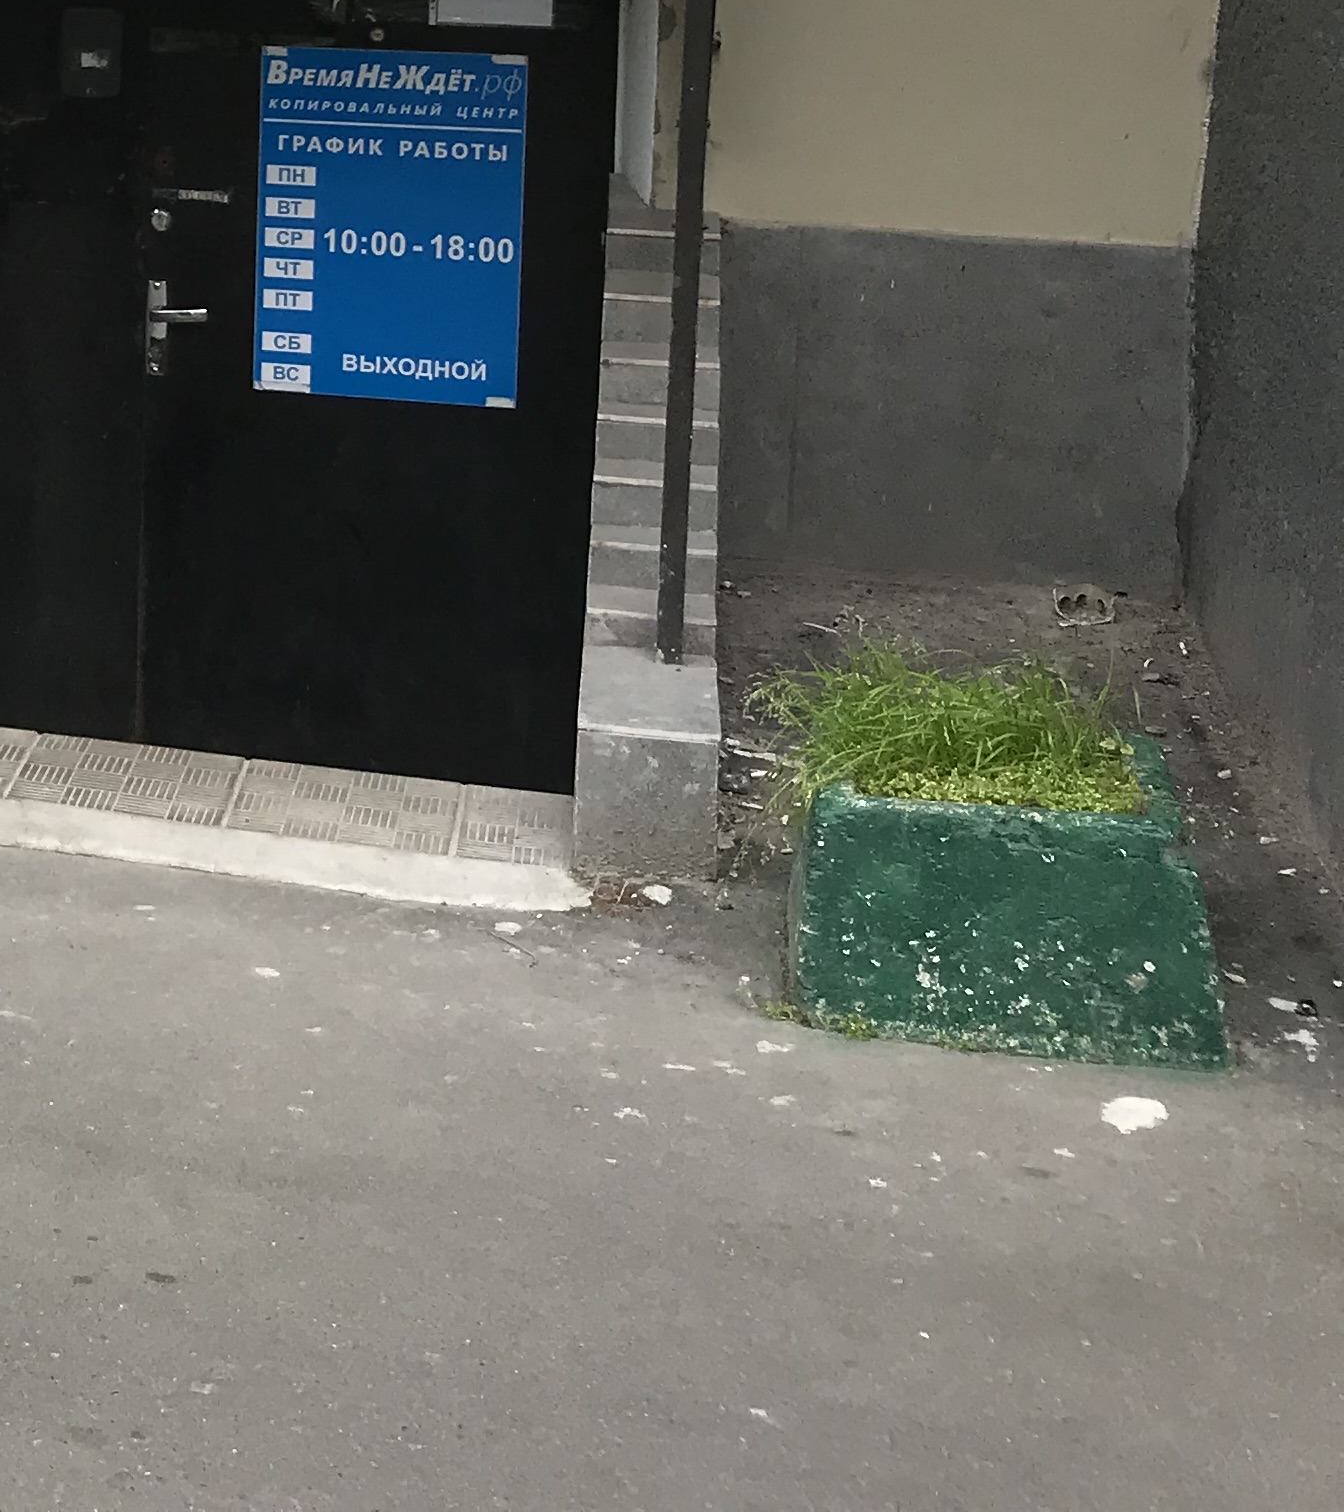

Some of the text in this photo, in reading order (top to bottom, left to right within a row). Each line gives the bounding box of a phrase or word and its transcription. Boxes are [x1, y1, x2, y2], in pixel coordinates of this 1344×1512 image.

[268, 98, 519, 120] КОПИРОВАЛЬНЫЙ ЦЕНТР
[278, 135, 509, 162] ГРАФИК РАБОТЫ
[278, 168, 306, 183] ПН
[277, 200, 302, 215] ВТ
[276, 231, 303, 246] СР
[275, 261, 301, 276] ЧТ
[274, 292, 301, 307] ПТ
[273, 334, 301, 350] СБ
[273, 366, 299, 381] ВС
[342, 353, 487, 382] ВЫХОДНОЙ
